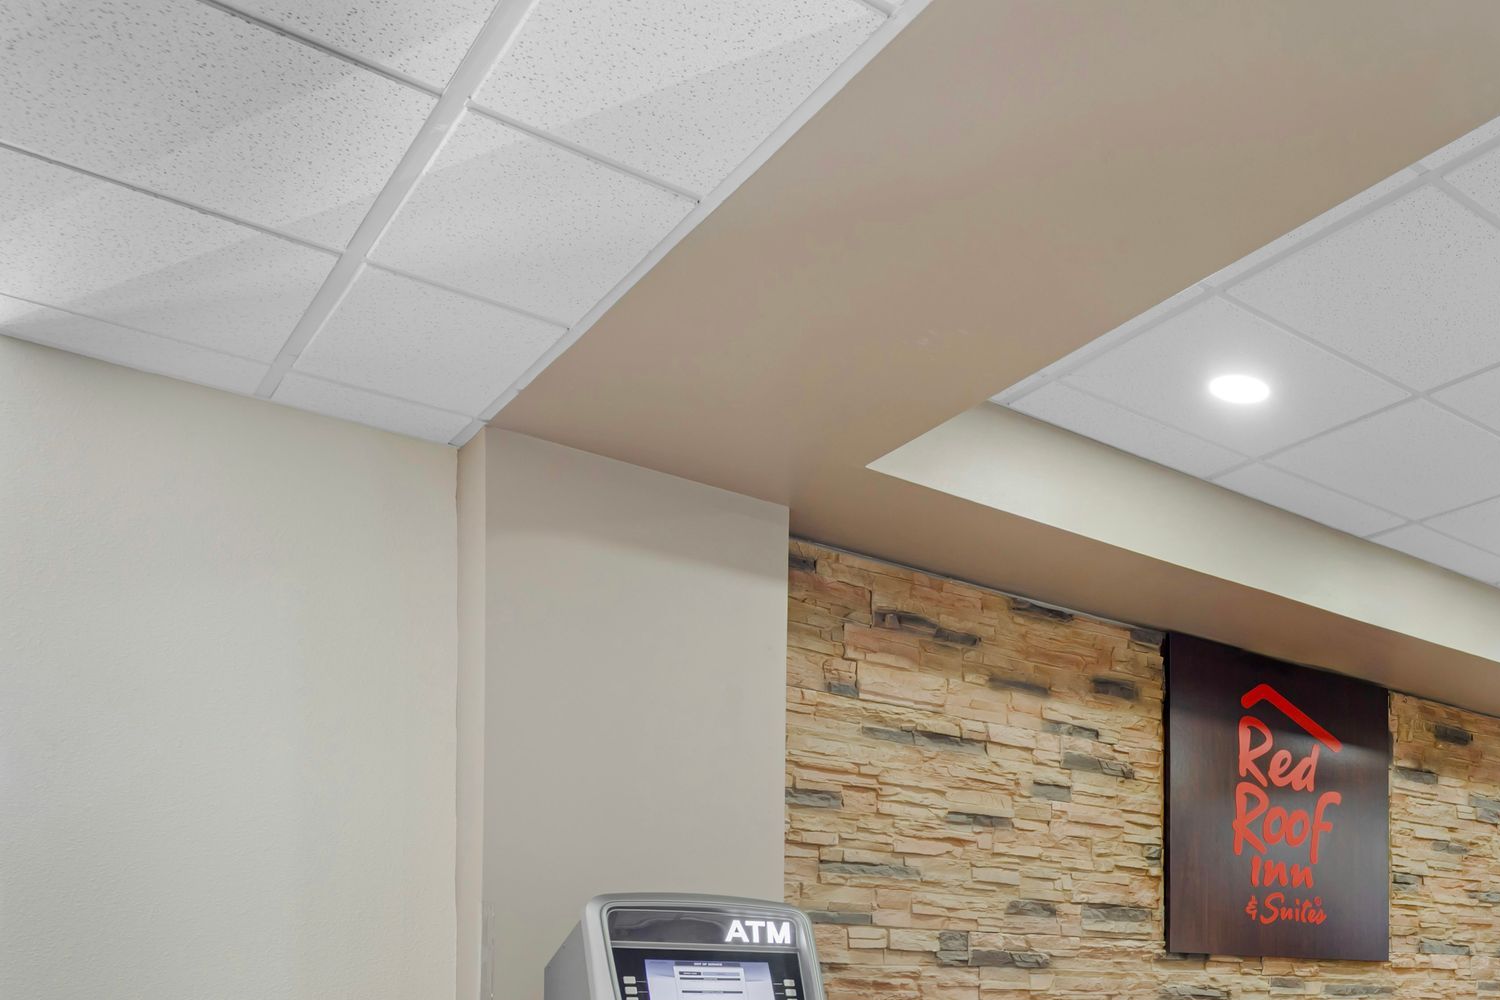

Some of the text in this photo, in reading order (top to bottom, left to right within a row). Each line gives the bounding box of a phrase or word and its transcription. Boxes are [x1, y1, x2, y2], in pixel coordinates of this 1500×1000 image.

[1238, 715, 1320, 793] Red
[1232, 781, 1342, 865] Roof
[1251, 855, 1314, 889] Inn
[1245, 891, 1327, 925] & Suites
[725, 919, 791, 945] ATM
